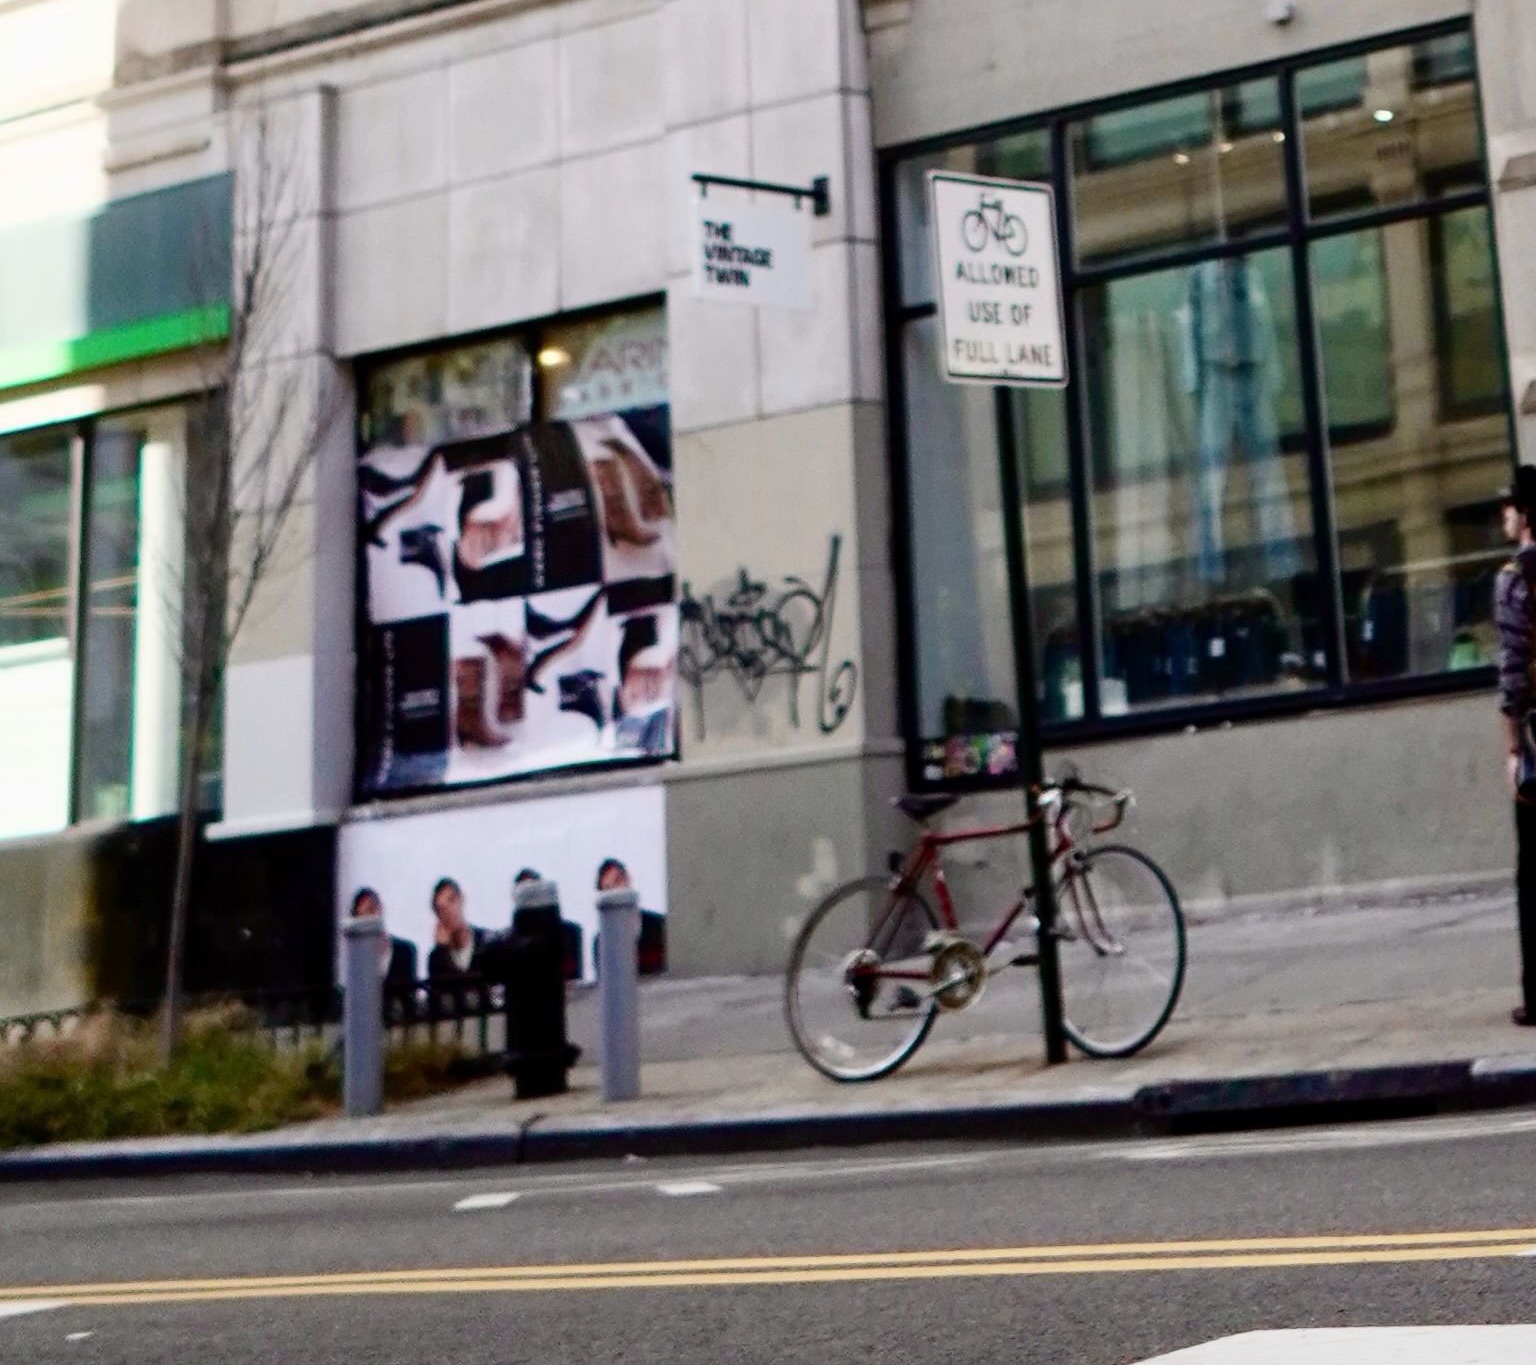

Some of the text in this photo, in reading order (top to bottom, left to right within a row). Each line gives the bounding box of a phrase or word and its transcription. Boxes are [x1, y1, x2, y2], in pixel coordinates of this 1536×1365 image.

[703, 220, 731, 242] THE
[704, 244, 773, 269] VINTAGE
[704, 263, 750, 287] TWIN
[955, 260, 1040, 288] ALLOWED
[968, 300, 1031, 325] USE OF
[954, 337, 1054, 367] FULL LANE
